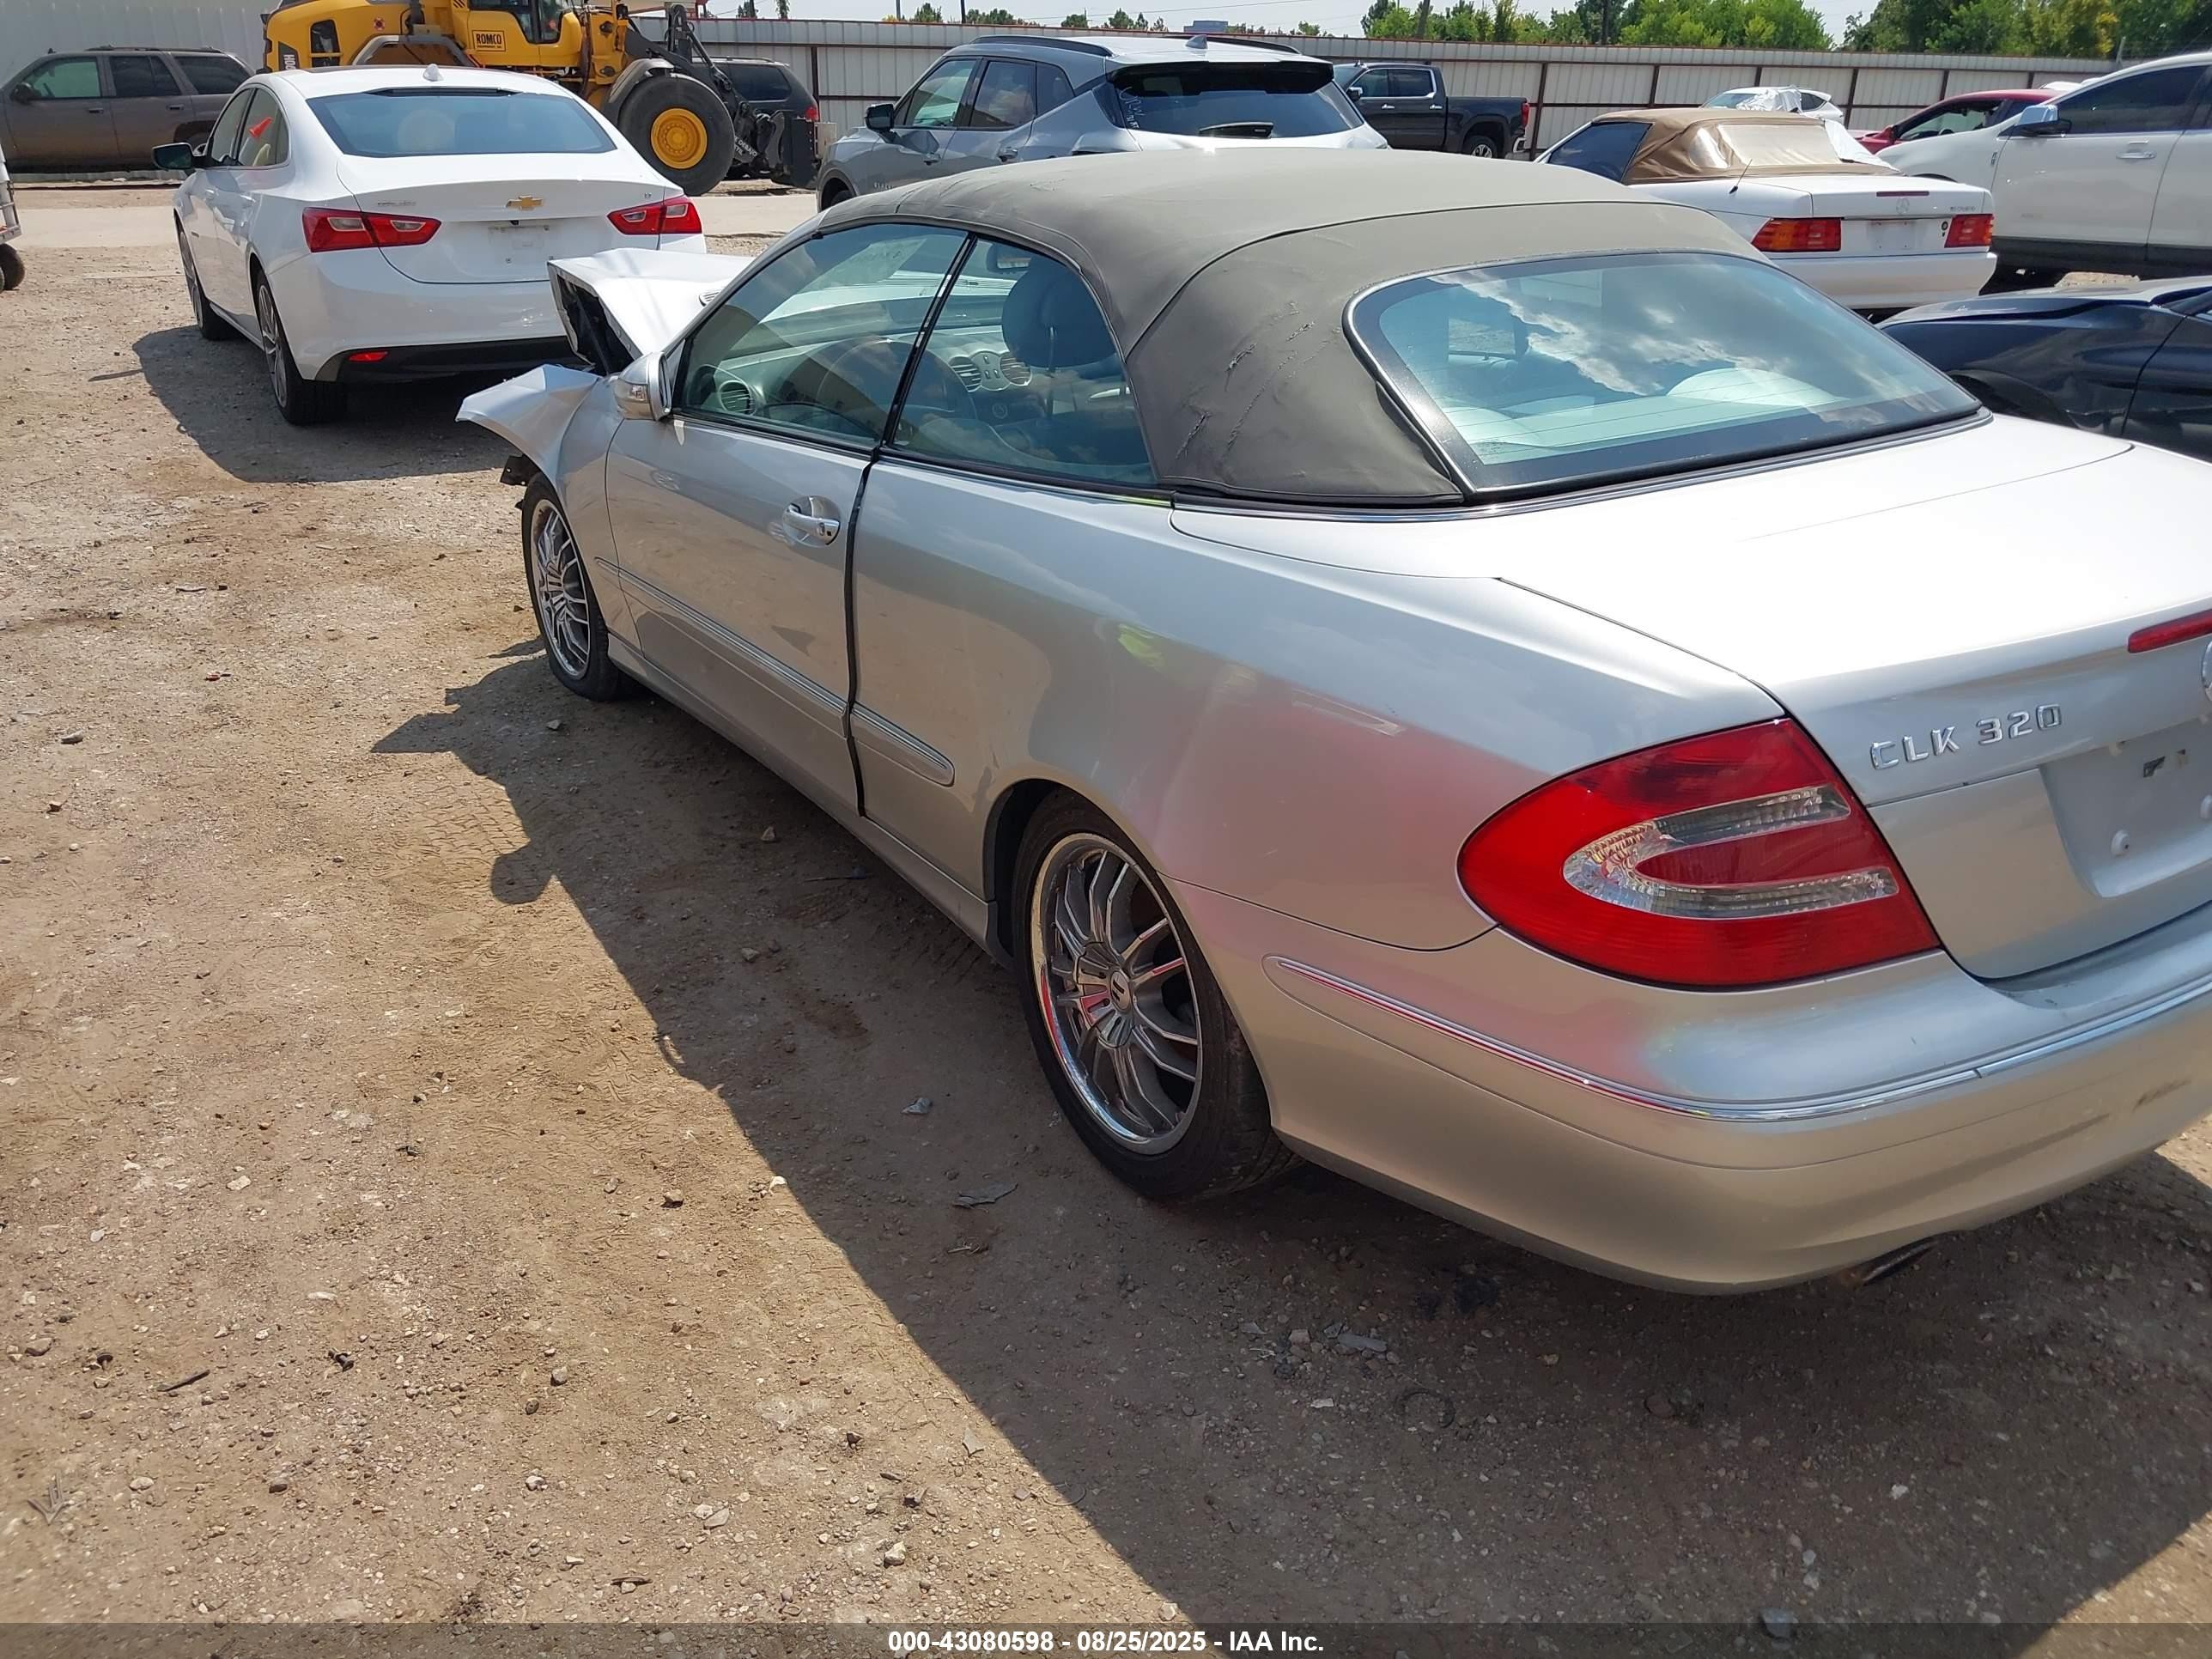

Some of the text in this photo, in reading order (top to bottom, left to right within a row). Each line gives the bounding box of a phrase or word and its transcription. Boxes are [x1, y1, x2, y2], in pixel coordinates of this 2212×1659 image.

[476, 33, 502, 45] ROMCO
[1870, 703, 2061, 770] CLK 320
